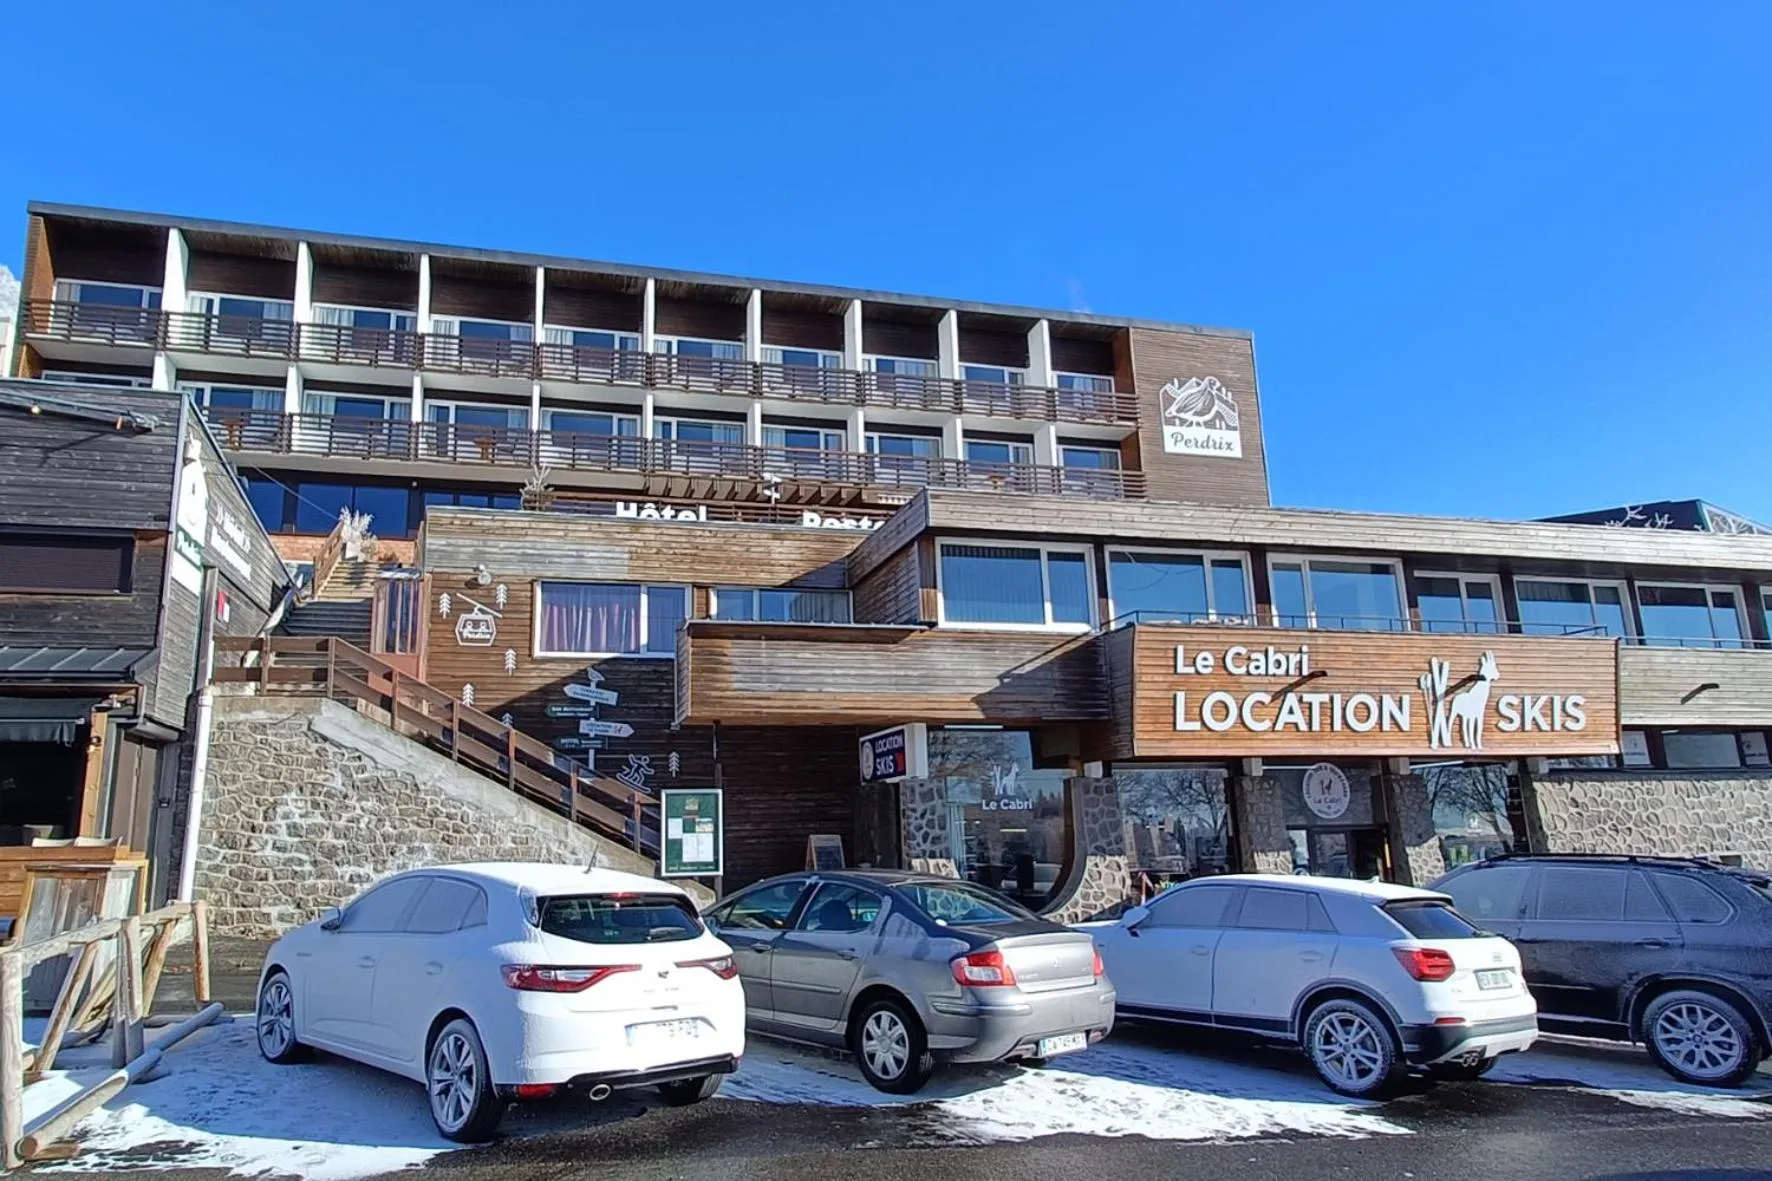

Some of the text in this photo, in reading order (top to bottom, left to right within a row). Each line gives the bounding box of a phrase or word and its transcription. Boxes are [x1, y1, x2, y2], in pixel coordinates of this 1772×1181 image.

[1170, 431, 1235, 452] Perdrix
[615, 501, 707, 522] Hôtel
[1175, 644, 1309, 676] Le Cabri
[1174, 690, 1587, 732] LOCATION SKIS
[874, 734, 904, 753] LOCATION
[875, 754, 895, 775] SKIS
[982, 799, 1033, 810] Le Cabri
